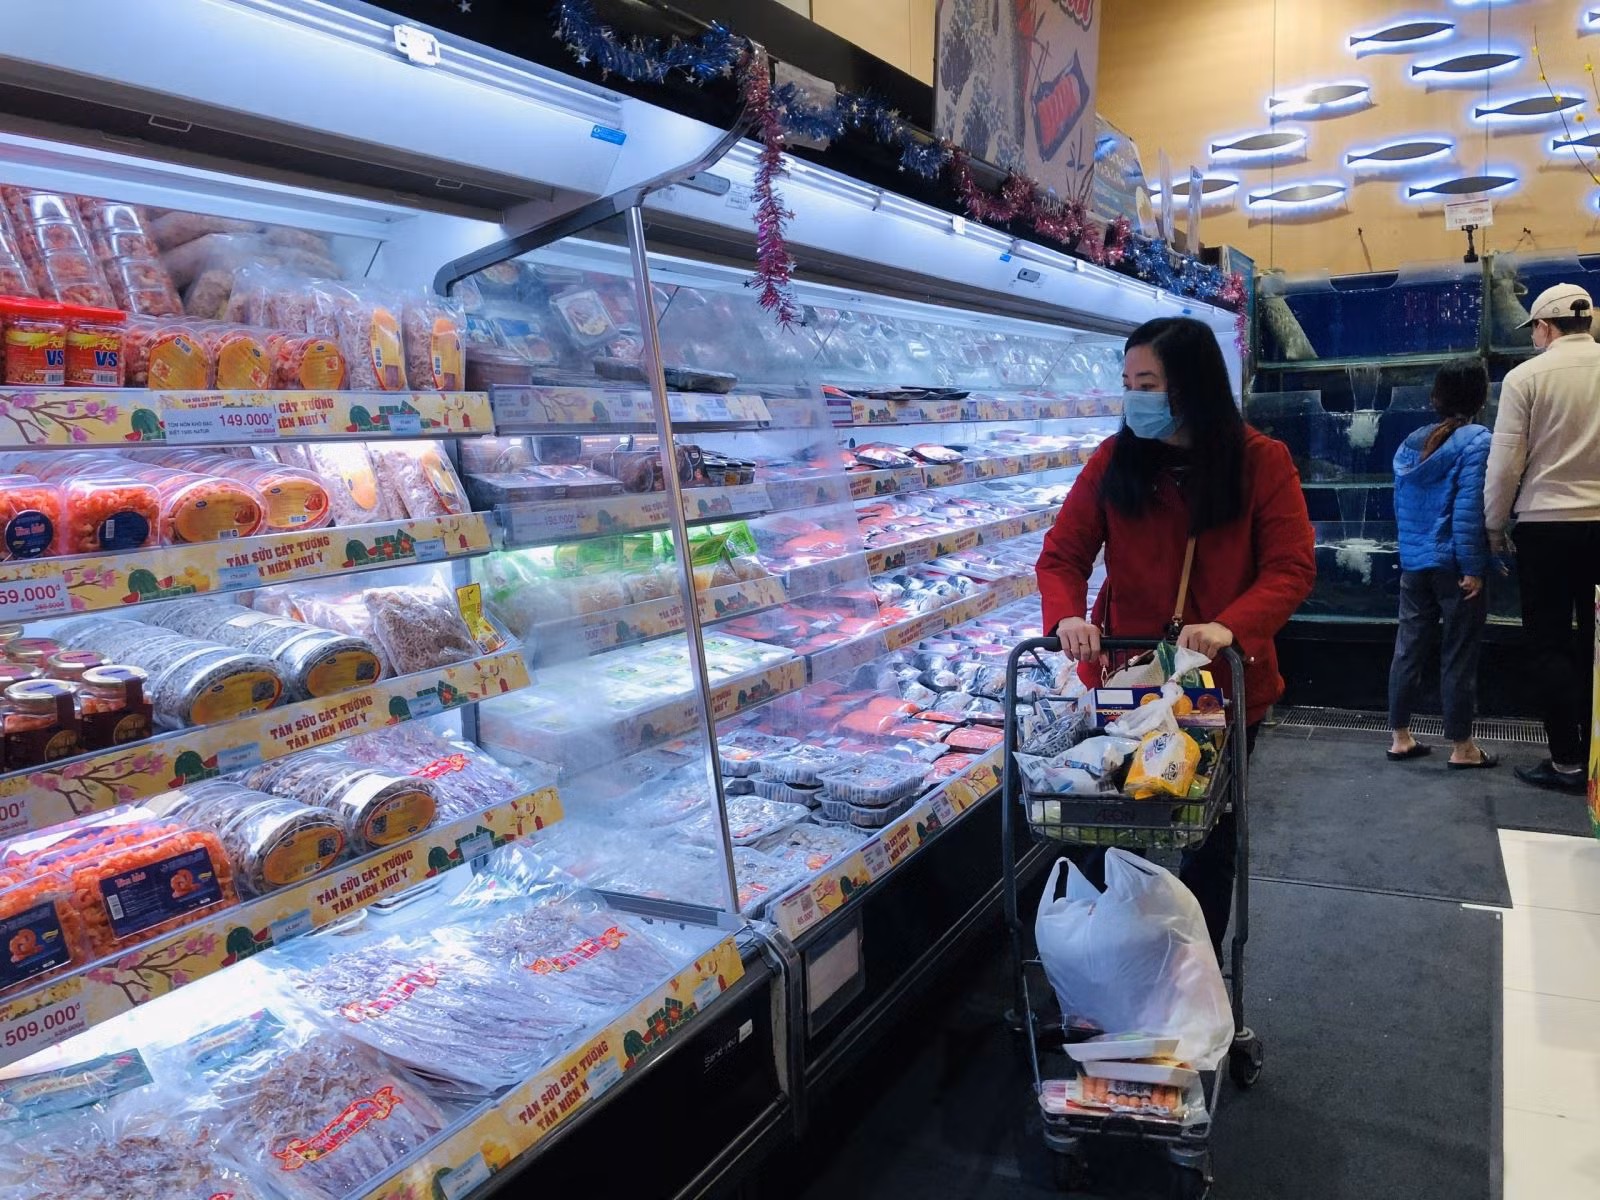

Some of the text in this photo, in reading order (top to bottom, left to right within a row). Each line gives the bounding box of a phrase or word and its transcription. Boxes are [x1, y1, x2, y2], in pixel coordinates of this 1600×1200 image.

[45, 349, 64, 366] VS
[94, 349, 118, 367] VS
[270, 695, 373, 740] TÂN SỬU CÁT TƯỜNG
[286, 734, 309, 750] TÂN
[311, 724, 336, 741] NIÊN
[338, 714, 359, 731] NHƯ
[316, 850, 414, 905] TÂN SỬU CÁT TƯỜNG
[332, 896, 354, 914] TÂN
[355, 883, 379, 903] NIÊN
[380, 869, 400, 890] NHƯ
[5, 1002, 80, 1047] 509.000đ
